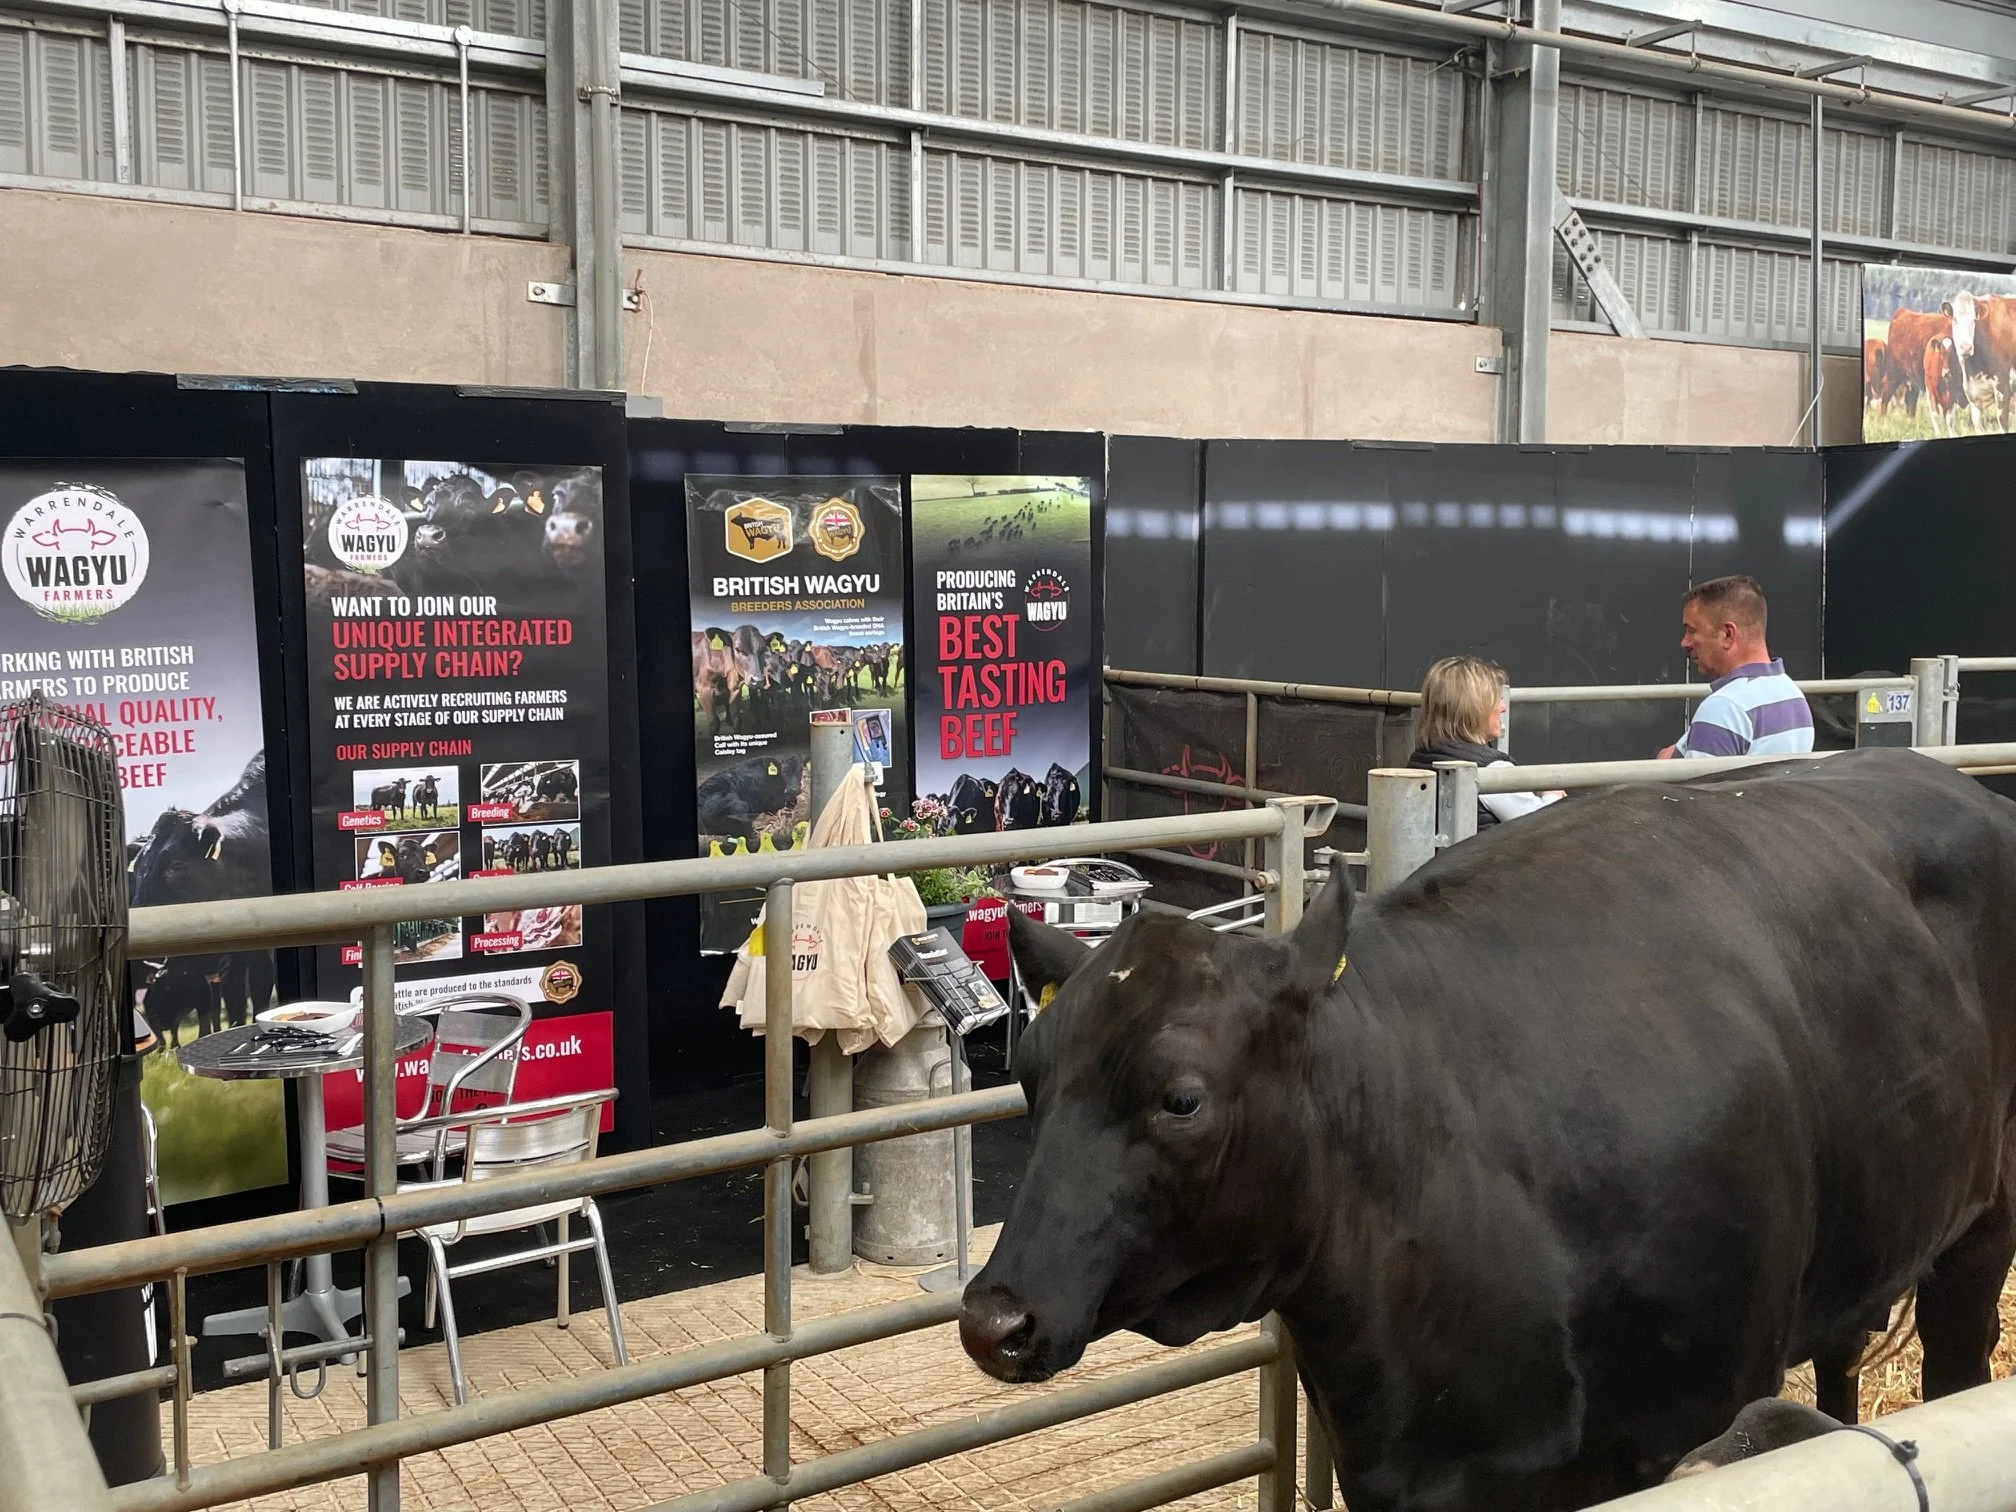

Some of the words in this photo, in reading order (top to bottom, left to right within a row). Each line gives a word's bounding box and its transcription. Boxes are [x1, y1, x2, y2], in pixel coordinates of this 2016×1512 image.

[14, 497, 135, 540] WARRENDALE
[336, 501, 400, 525] WARRENDALE
[341, 534, 396, 553] WAGYU
[26, 555, 128, 587] WAGYU
[936, 569, 1016, 589] PRODUCING
[44, 588, 114, 602] FARMERS
[713, 575, 800, 597] BRITISH
[804, 574, 880, 595] WAGYU
[331, 596, 383, 618] WANT
[387, 596, 411, 617] TO
[415, 596, 453, 617] JOIN
[459, 596, 497, 616] OUR
[731, 601, 792, 612] BREEDERS
[794, 599, 865, 611] ASSOCIATION
[937, 592, 1004, 611] BRITAIN'S
[1026, 601, 1067, 622] WAGYU
[332, 620, 426, 651] UNIQUE
[433, 619, 572, 647] INTEGRATED
[938, 614, 1020, 662] BEST
[0, 651, 62, 673] RKING
[66, 649, 116, 670] WITH
[121, 645, 194, 667] BRITISH
[333, 652, 427, 680] SUPPLY
[435, 650, 523, 678] CHAIN?
[0, 677, 68, 701] RMERS
[72, 676, 97, 696] TO
[103, 671, 190, 693] PRODUCE
[938, 659, 1068, 711] TASTING
[334, 696, 353, 710] WE
[356, 695, 380, 710] ARE
[383, 693, 438, 709] ACTIVELY
[441, 691, 512, 707] RECRUITING
[514, 690, 568, 705] FARMERS
[1889, 694, 1909, 711] 137
[119, 697, 223, 728] QUALITY,
[334, 714, 350, 729] AT
[353, 713, 391, 728] EVERY
[394, 711, 432, 727] STAGE
[434, 711, 450, 726] OF
[453, 710, 479, 725] OUR
[481, 709, 526, 724] SUPPLY
[528, 707, 564, 722] CHAIN
[940, 712, 1017, 760] BEEF
[336, 744, 367, 761] OUR
[372, 741, 425, 759] SUPPLY
[429, 740, 472, 757] CHAIN
[342, 814, 382, 828] Genetics
[471, 806, 510, 821] Breeding
[474, 934, 520, 949] Processing
[394, 988, 412, 999] attle
[414, 987, 428, 997] are
[430, 982, 467, 997] produced
[469, 982, 477, 991] to
[479, 981, 492, 990] the
[494, 976, 532, 988] standards
